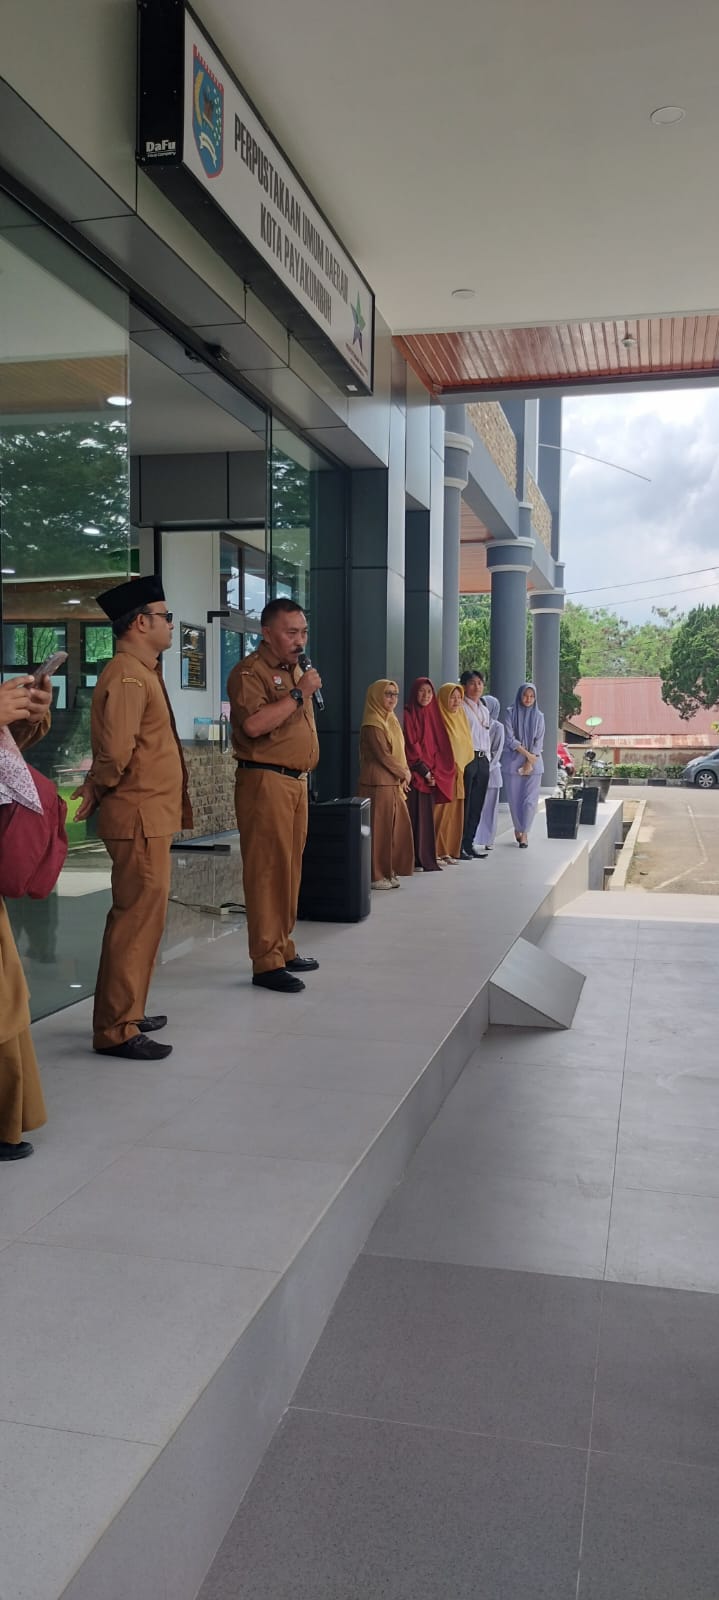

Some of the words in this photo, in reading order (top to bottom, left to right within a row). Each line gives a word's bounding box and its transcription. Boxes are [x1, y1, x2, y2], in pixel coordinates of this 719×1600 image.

[145, 139, 176, 152] DaFu
[235, 112, 301, 238] PERPUSTAKAAN
[303, 211, 324, 270] UMUM
[325, 245, 349, 304] DAERAH
[261, 202, 282, 262] KOTA
[285, 234, 331, 326] PAYAKUMBUH
